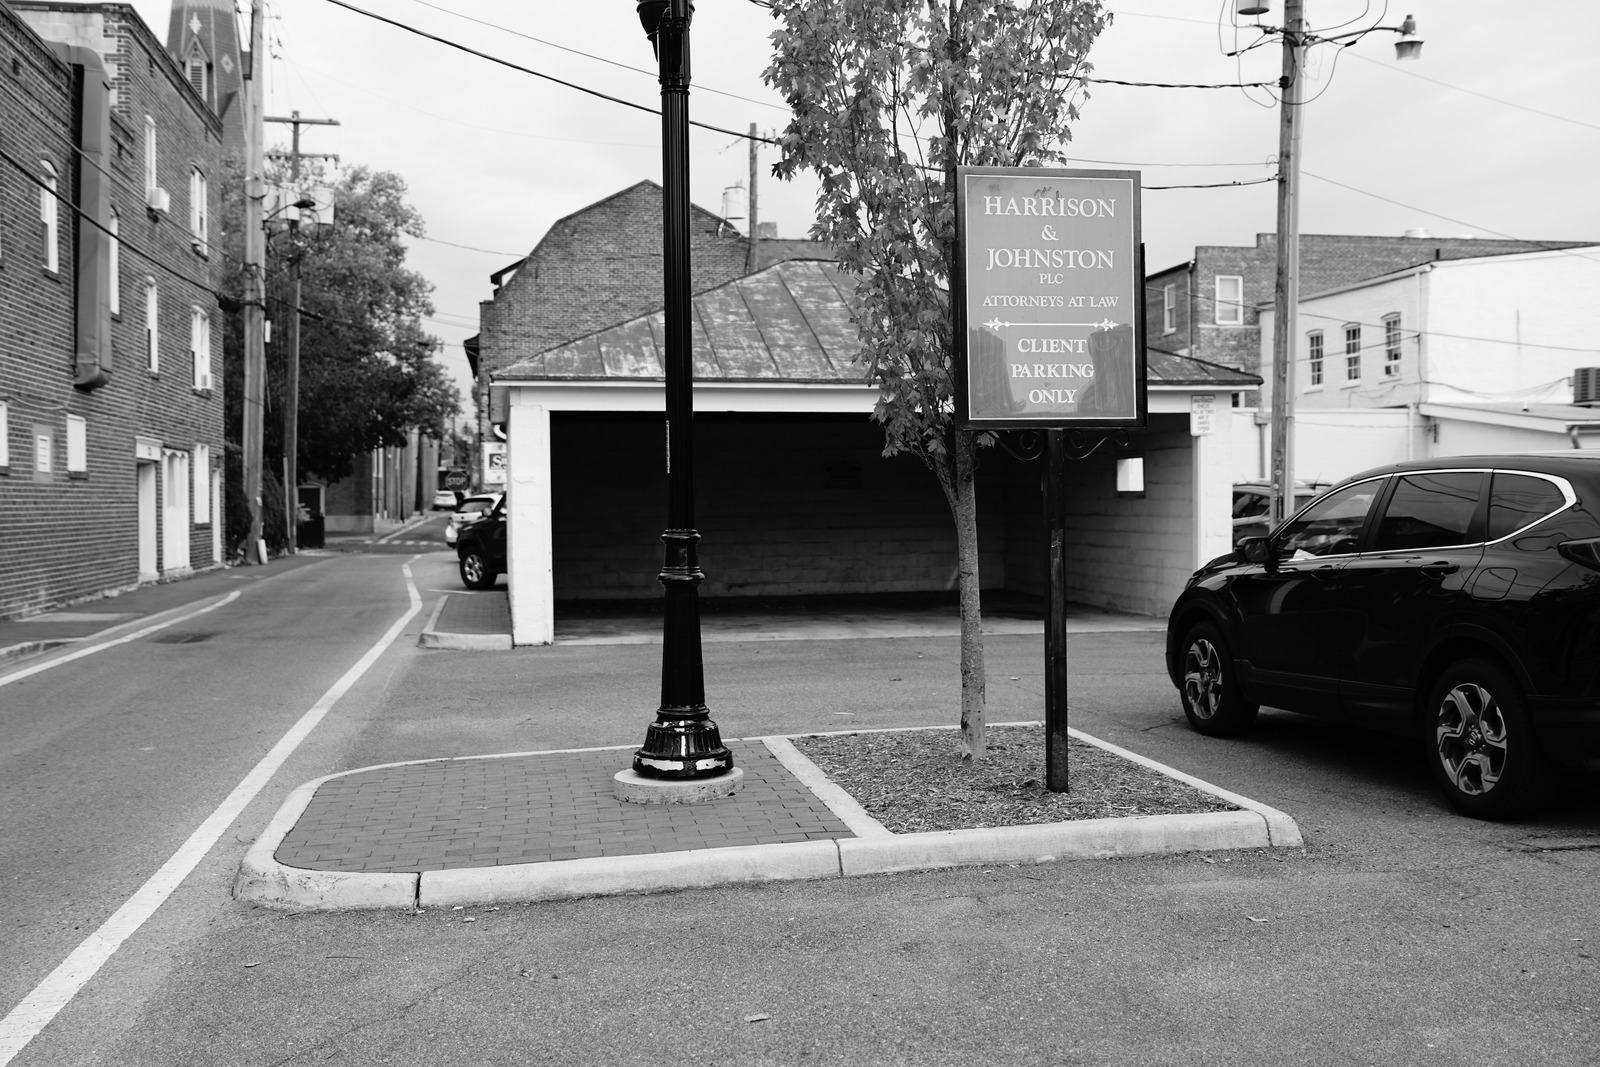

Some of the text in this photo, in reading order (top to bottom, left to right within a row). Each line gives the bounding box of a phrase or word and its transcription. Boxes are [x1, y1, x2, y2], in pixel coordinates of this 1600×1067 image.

[983, 196, 1116, 218] HARRISON
[1041, 224, 1060, 241] &
[986, 248, 1115, 270] JOHNSTON
[1039, 273, 1064, 285] PLC
[982, 295, 1120, 308] ATTORNEYS AT LAW
[1017, 338, 1088, 353] CLIENT
[1010, 363, 1095, 379] PARKING
[1028, 389, 1078, 404] ONLY
[447, 477, 466, 486] STOP
